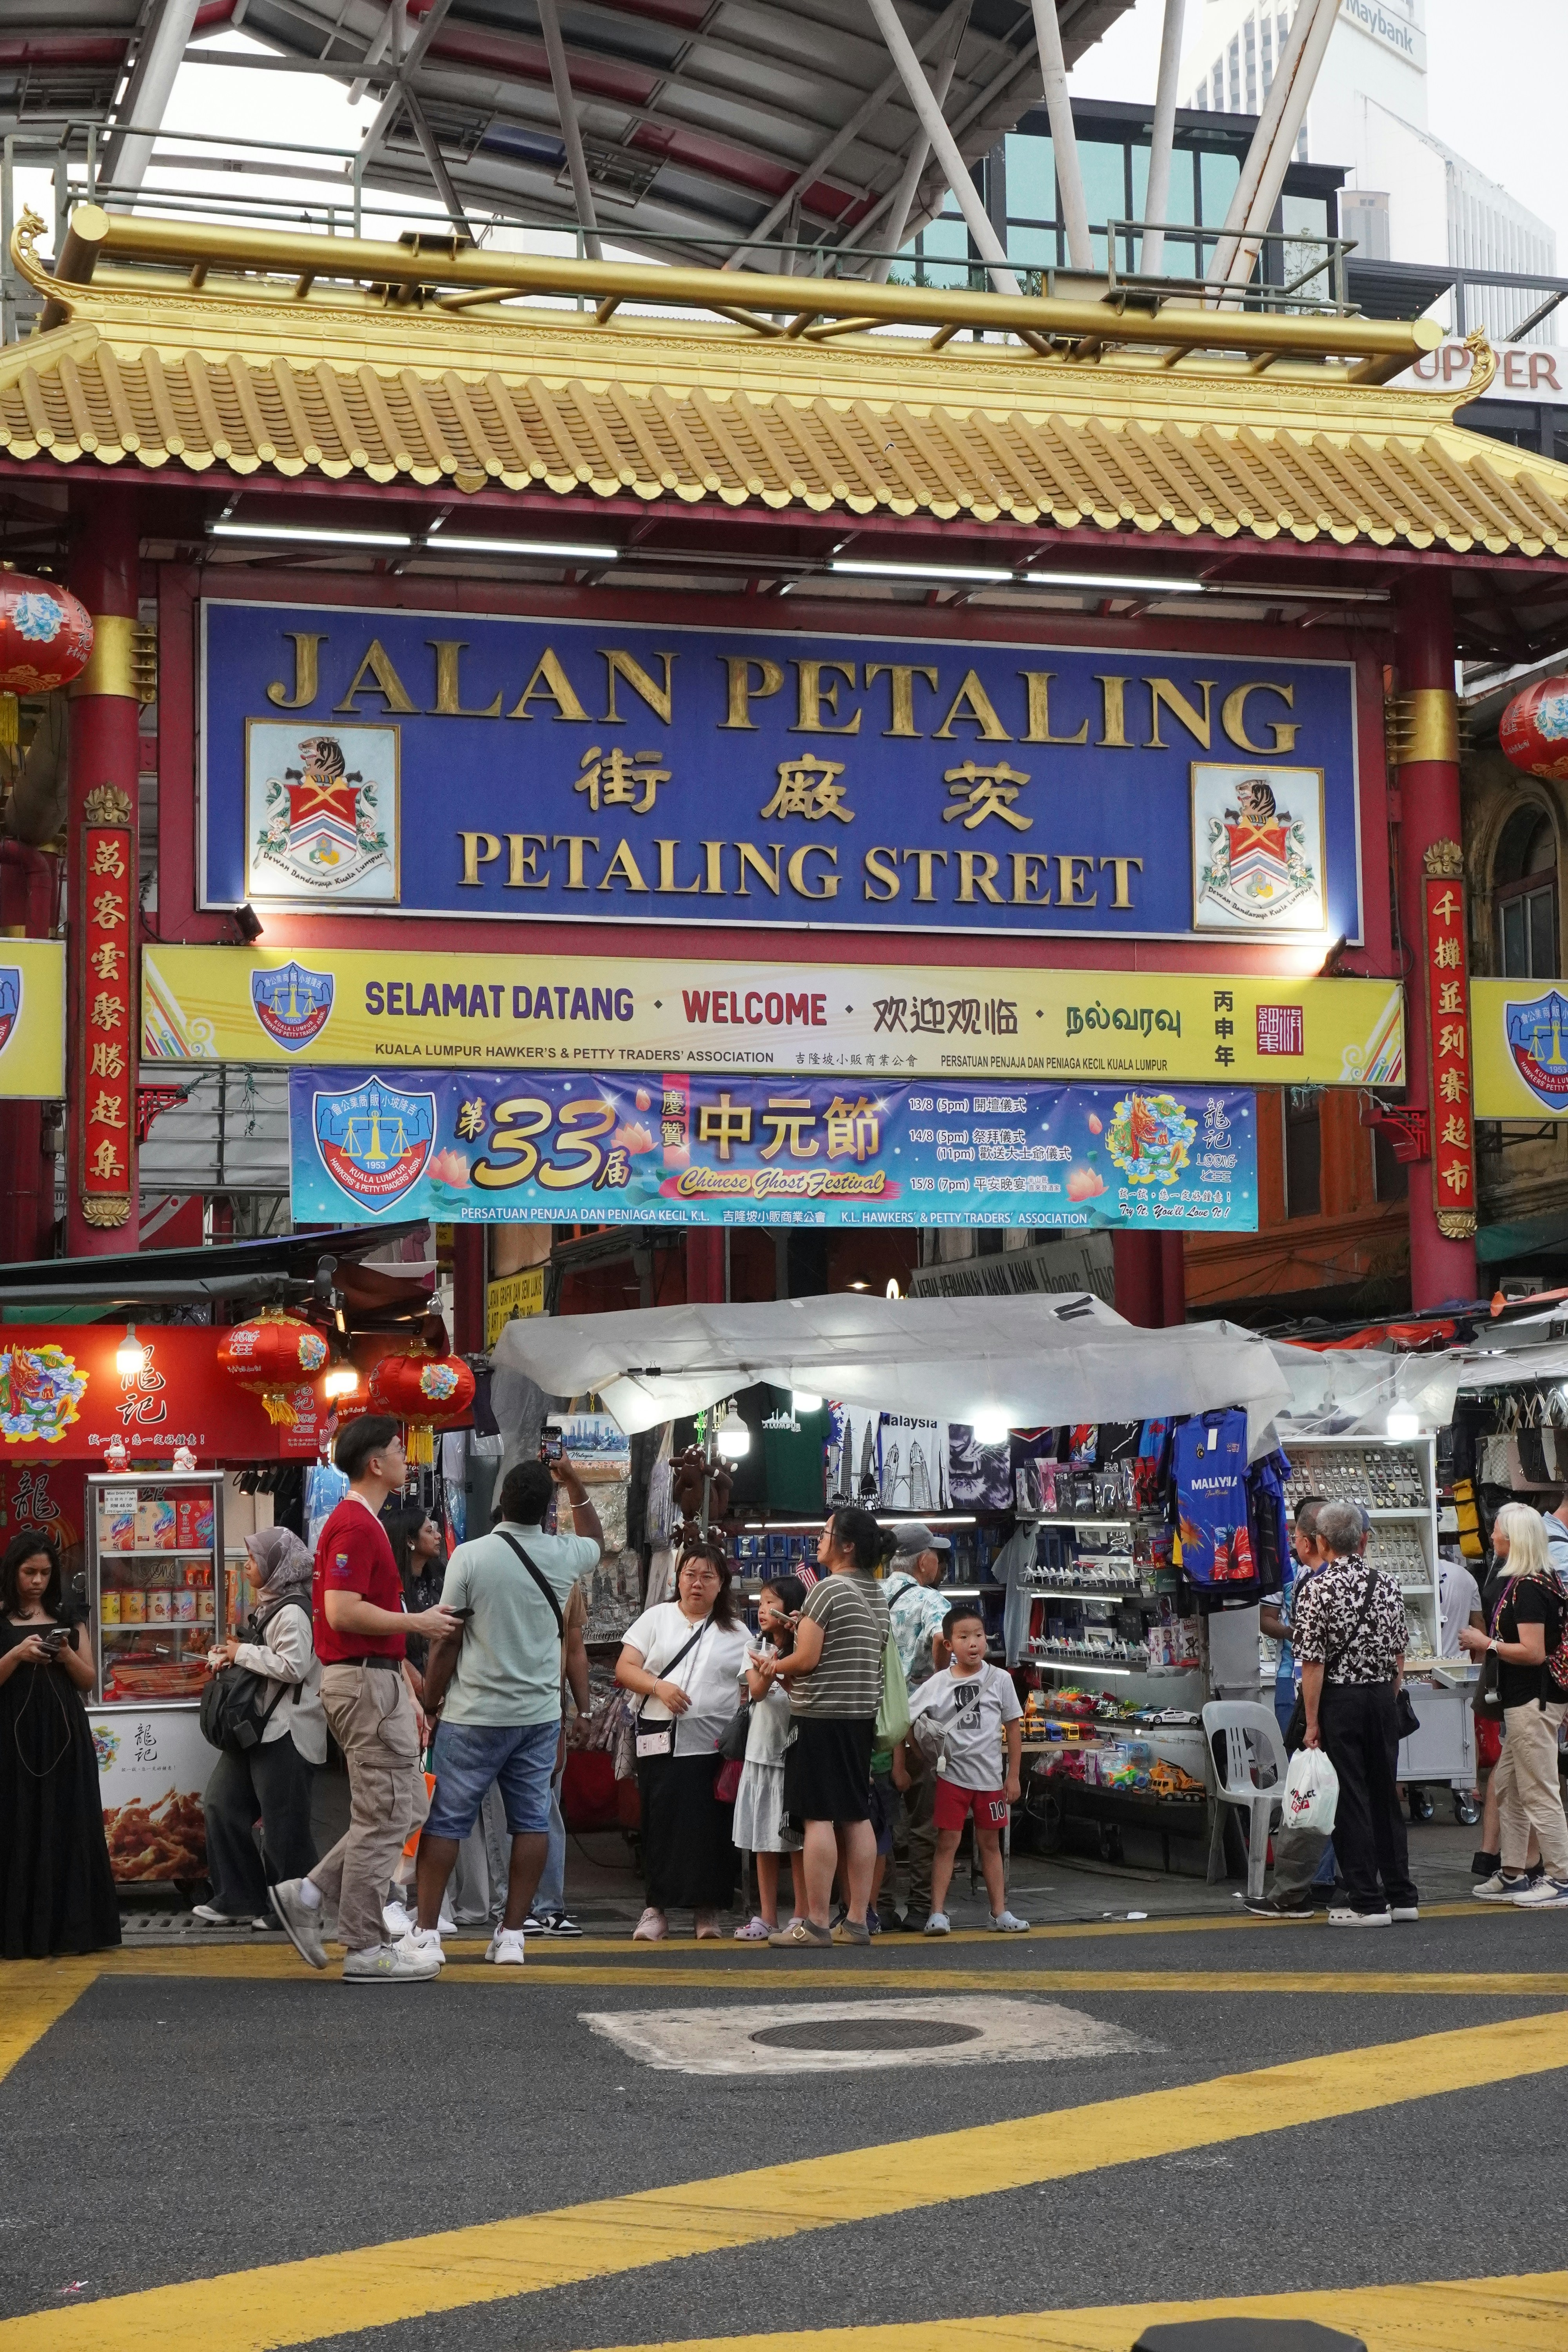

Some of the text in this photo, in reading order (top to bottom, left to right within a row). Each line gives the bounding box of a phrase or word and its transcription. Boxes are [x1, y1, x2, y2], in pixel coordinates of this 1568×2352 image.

[1345, 0, 1414, 55] Maybank
[1413, 344, 1562, 390] UPER
[267, 633, 1302, 754] JALAN PETALING
[263, 852, 290, 871] Dewan
[335, 872, 356, 885] Kuala
[356, 852, 383, 877] Lumpur
[457, 831, 1143, 909] PETALING STREET
[1208, 886, 1312, 920] Dewan Bandaraya Kuala Lumpur
[365, 981, 827, 1026] SELAMAT DATANG WELCOME
[316, 1011, 325, 1024] ASSN.
[873, 996, 1018, 1035] 欢迎观临
[1066, 1000, 1181, 1038] நல்வரவு
[274, 1019, 314, 1031] KUALA LUMPUR
[1214, 991, 1235, 1067] 丙申年
[1432, 891, 1470, 1195] 千攤並列賽超市
[375, 1044, 421, 1055] KUALA
[426, 1045, 482, 1057] LUMPUR
[561, 1048, 569, 1058] &
[573, 1049, 615, 1060] PETTY
[687, 1051, 774, 1063] ASSOCIATION
[795, 1052, 918, 1067] 吉隆坡小販商業公會
[941, 1055, 1168, 1071] PERSATUAN PENJAJA DAN PENIAGA KECIL KUALA LUMPUR
[1535, 1068, 1555, 1083] KUALA
[909, 1098, 1027, 1113] 13/8 (5pm) 開壇儀式
[699, 1094, 882, 1160] 中元節
[1203, 1098, 1230, 1149] 龍記
[909, 1129, 1025, 1145] 14/8 (5pm) 祭拜儀式
[937, 1147, 974, 1161] (11pm)
[1196, 1154, 1237, 1168] LOONG
[349, 1164, 407, 1183] KUALA LUMPUR
[366, 1161, 386, 1169] 1953
[407, 1158, 423, 1176] ASSN.
[681, 1169, 882, 1196] Chinese Ghost Festival
[910, 1177, 1026, 1192] 15/8 (7pm) 平安晚宴
[1200, 1171, 1231, 1182] KEE
[461, 1208, 710, 1221] PERSATUAN PENJAJA DAN PENIAGA KECIL K.L.
[723, 1210, 826, 1223] 吉隆坡小販商業公會
[841, 1212, 860, 1222] K.L.
[920, 1213, 928, 1223] &
[930, 1213, 962, 1223] PETTY
[1018, 1213, 1087, 1224] ASSOCIATION
[1119, 1204, 1133, 1218] Try
[1153, 1206, 1183, 1218] You'll
[1187, 1207, 1209, 1217] Love
[531, 1275, 541, 1298] LUKIS
[229, 1343, 254, 1356] KEE
[292, 1424, 314, 1433] KEE
[989, 1800, 1005, 1821] 10
